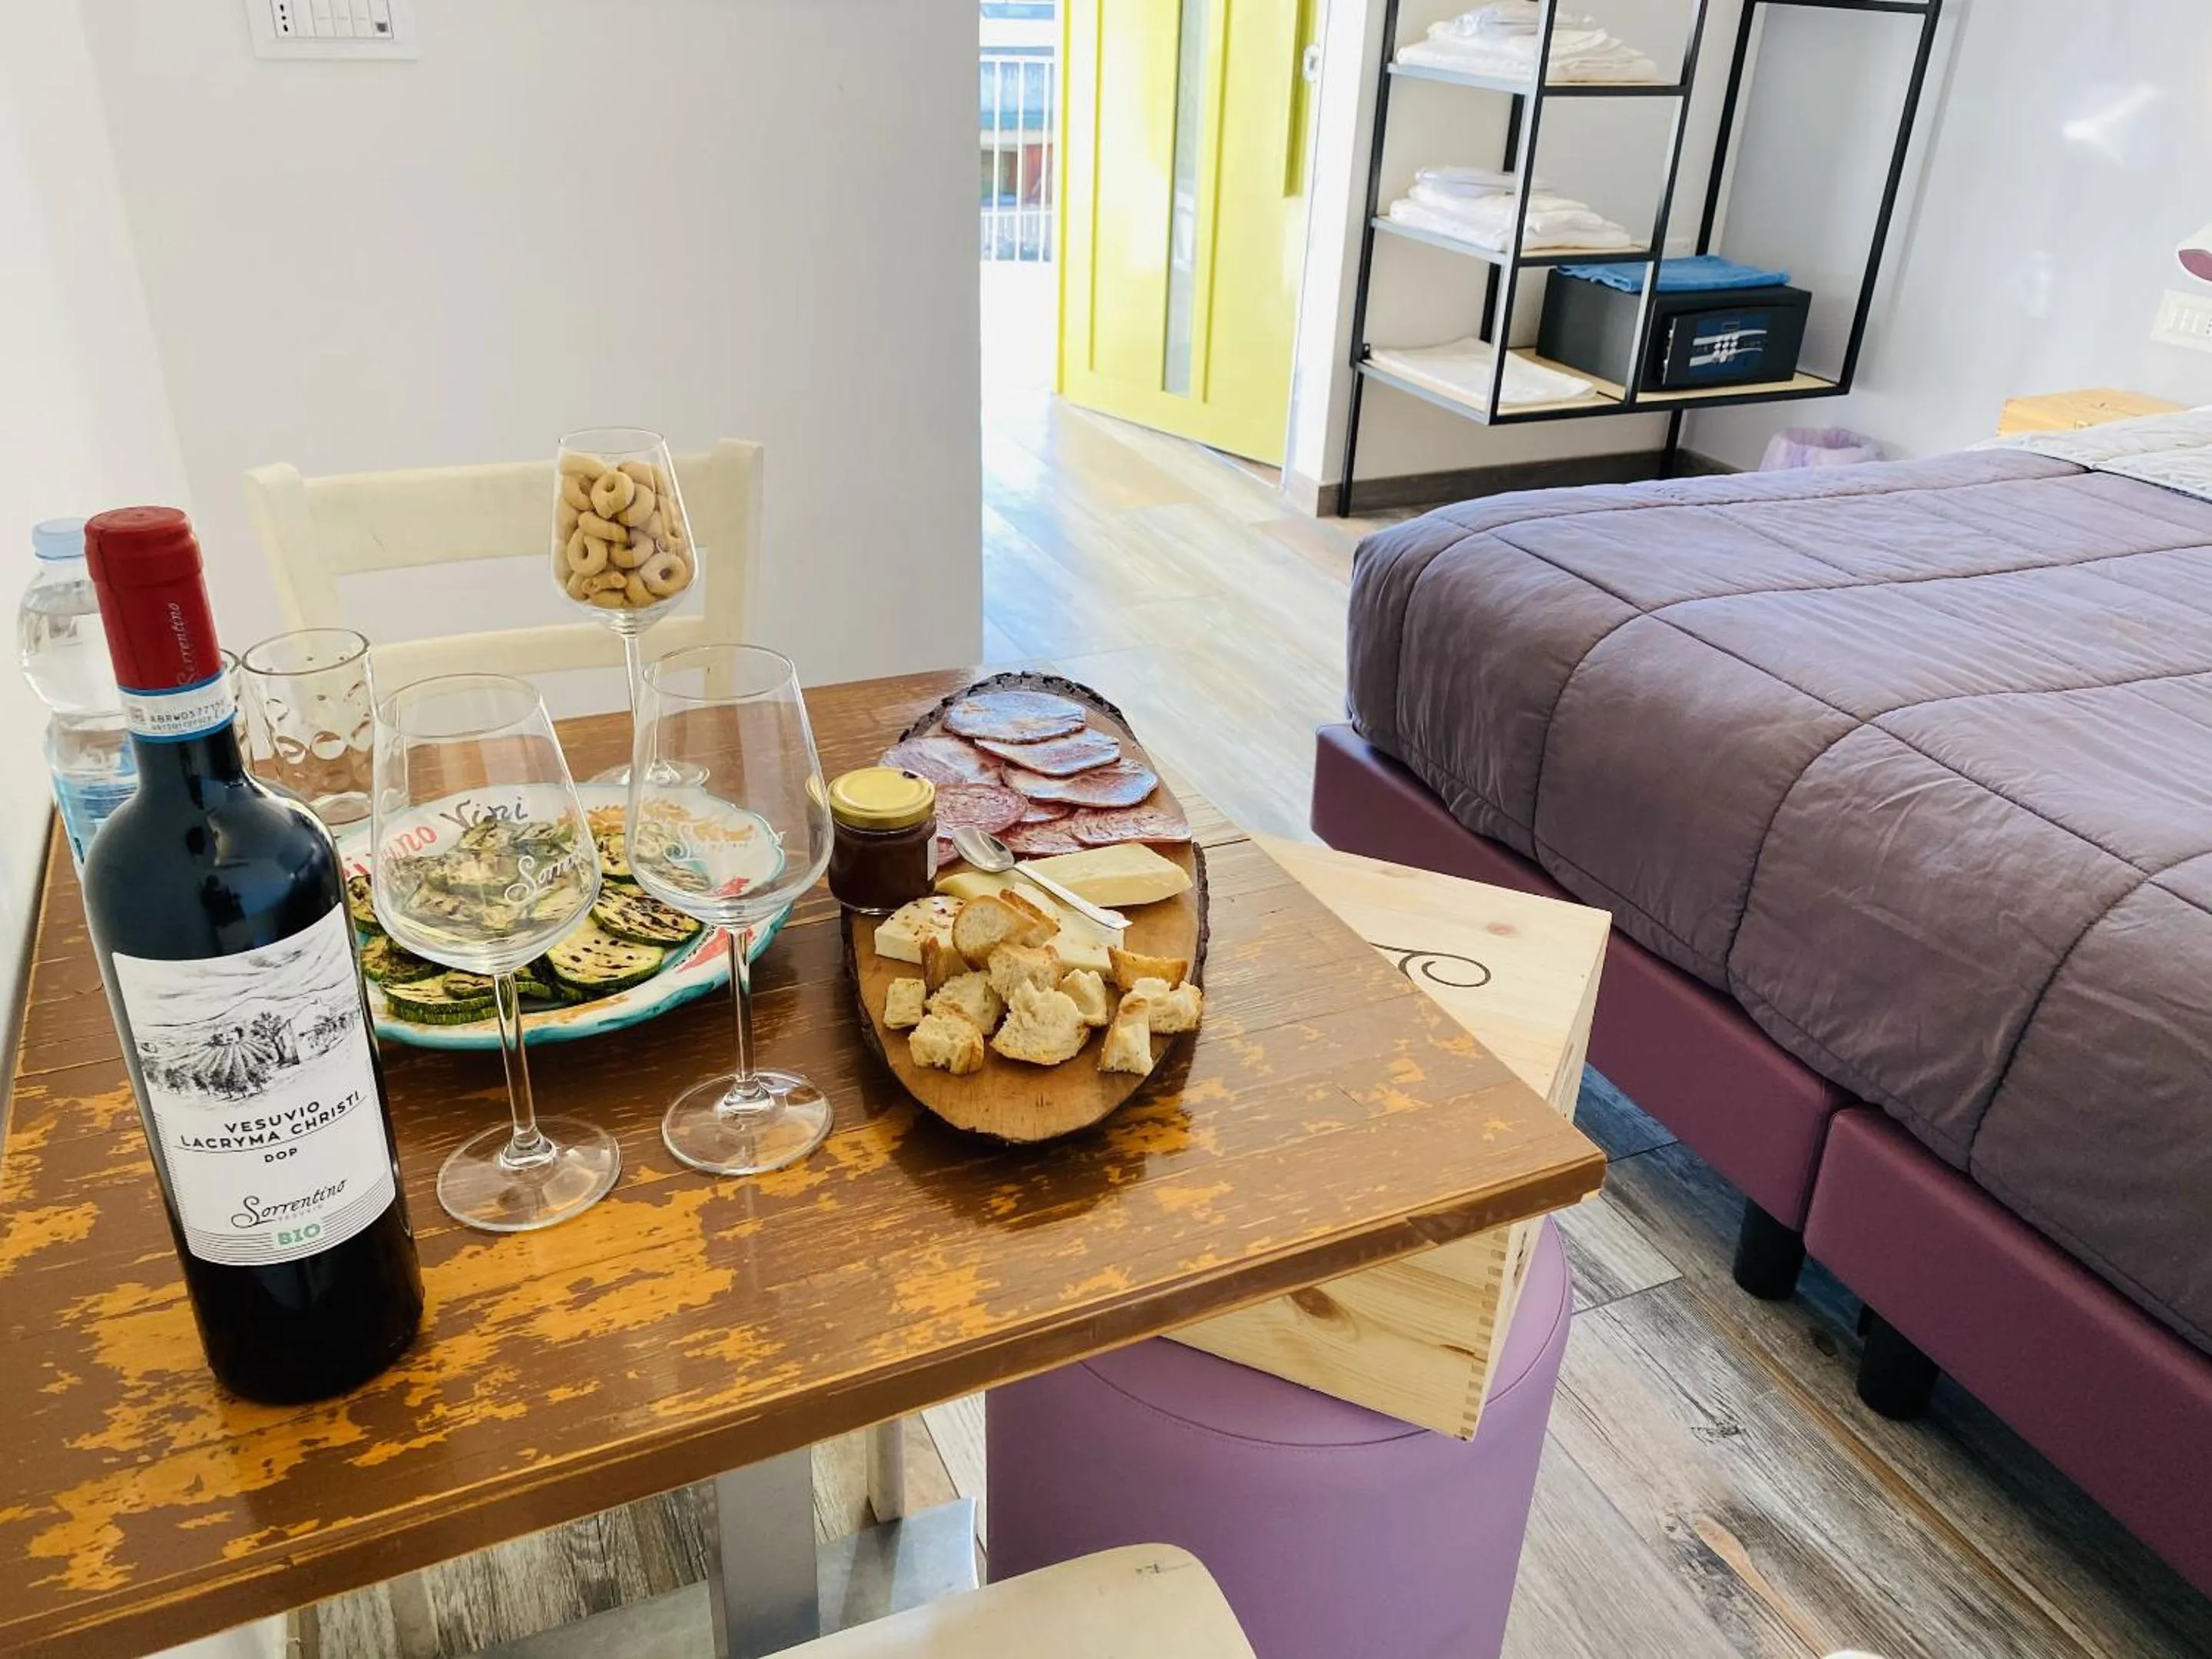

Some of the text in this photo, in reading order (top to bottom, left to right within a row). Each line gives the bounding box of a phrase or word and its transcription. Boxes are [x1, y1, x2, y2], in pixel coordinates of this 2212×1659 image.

[180, 1090, 359, 1149] LACRYMA CHRISTI
[224, 1101, 320, 1134] VESUVIO
[264, 1147, 298, 1163] DOP
[231, 1179, 347, 1229] Sorrentino
[277, 1223, 320, 1245] BIO
